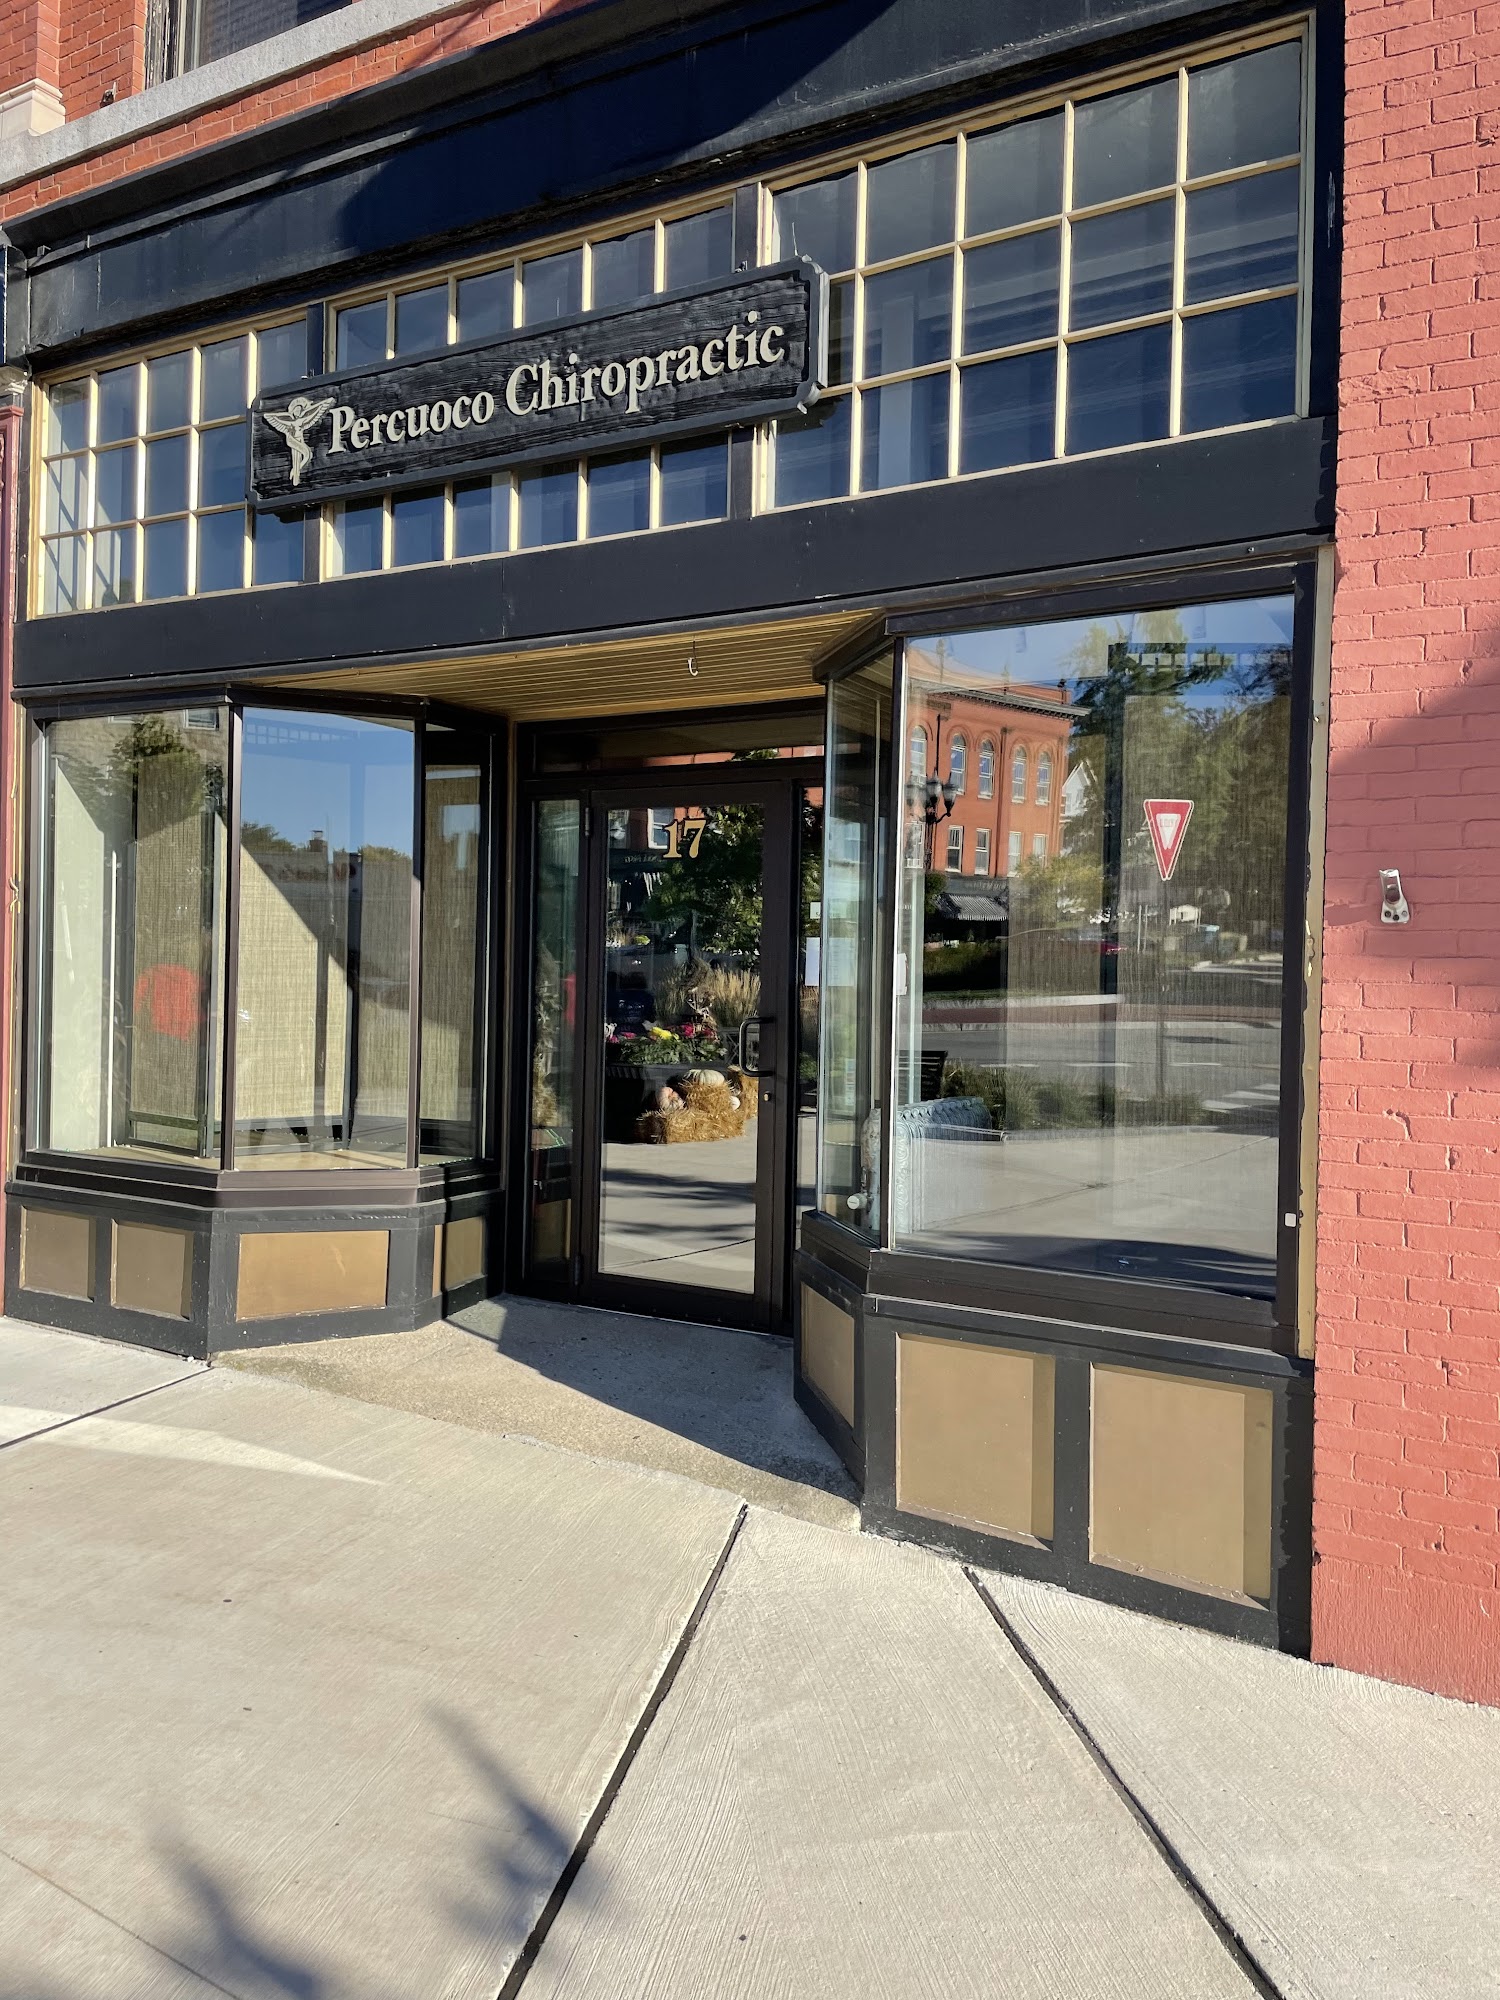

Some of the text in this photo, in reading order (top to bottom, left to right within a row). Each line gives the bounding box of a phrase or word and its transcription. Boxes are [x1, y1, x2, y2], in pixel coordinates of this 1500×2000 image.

[328, 310, 785, 454] Percuoco Chiropractic
[662, 819, 707, 859] 17
